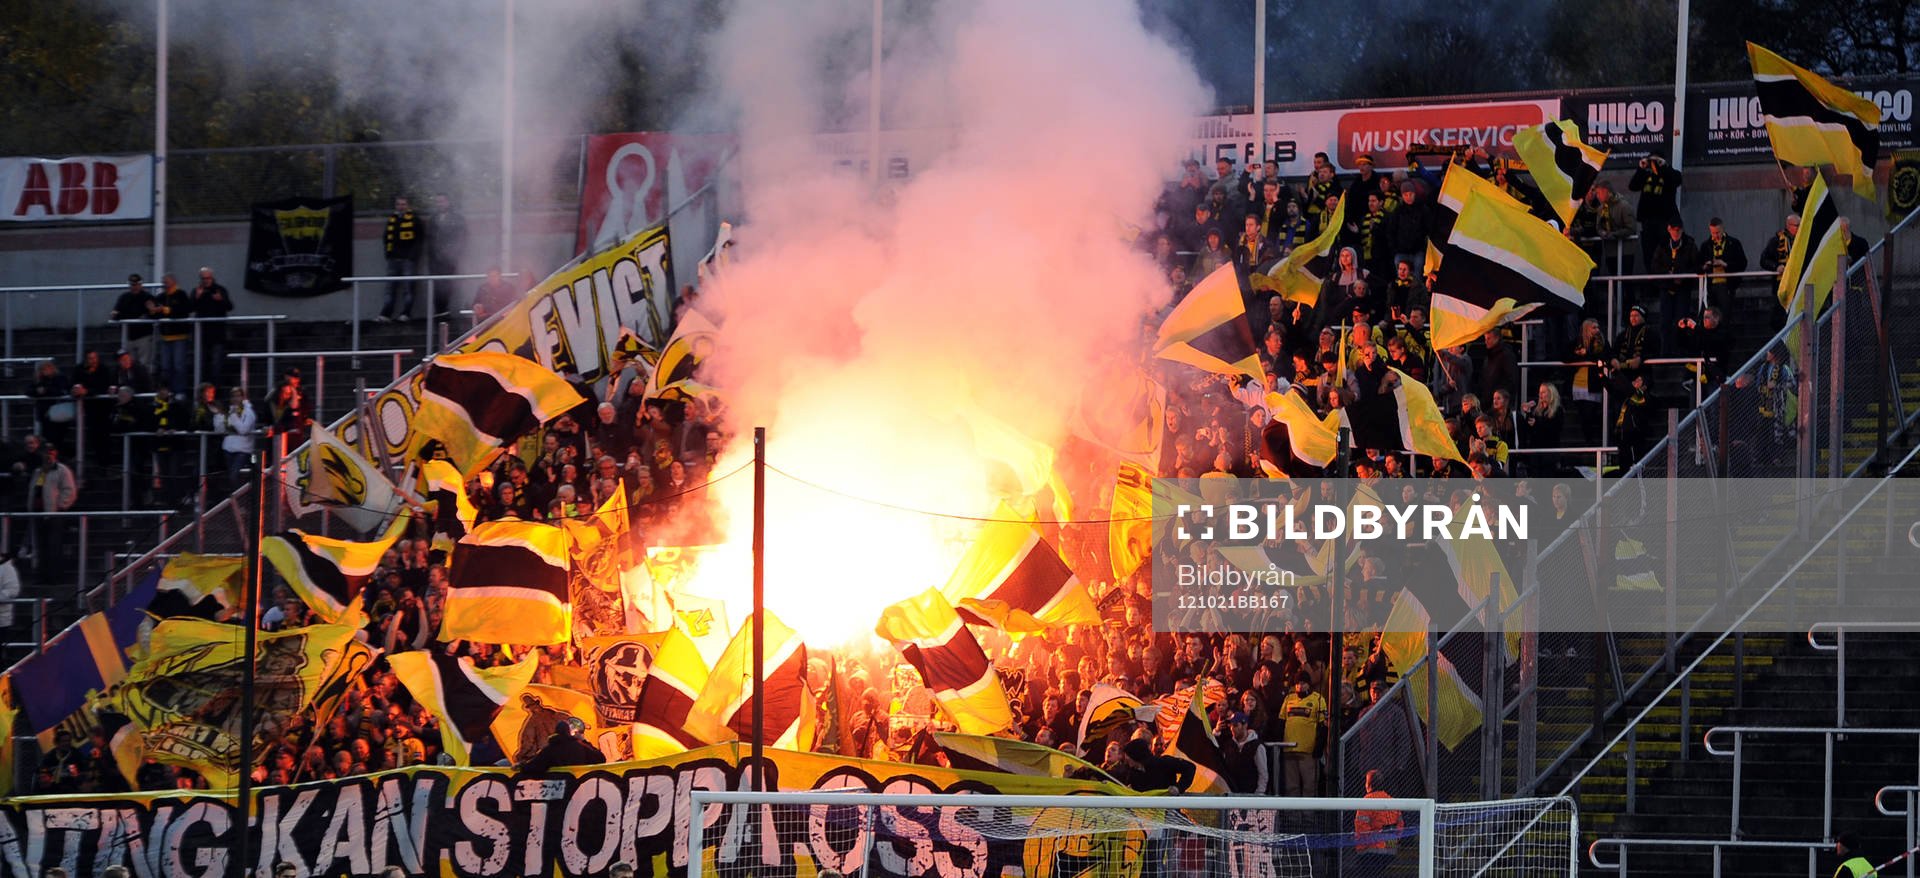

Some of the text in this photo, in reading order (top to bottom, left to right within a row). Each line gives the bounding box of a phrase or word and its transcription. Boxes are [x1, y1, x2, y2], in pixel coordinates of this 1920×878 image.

[1588, 101, 1665, 135] HUGO
[1709, 96, 1765, 130] HUG
[1588, 134, 1664, 145] BAR KÖK BOWLING
[1709, 131, 1723, 141] BAR
[1730, 129, 1745, 140] KÖK
[14, 162, 120, 216] ABB
[528, 240, 671, 376] EVIGT
[0, 802, 231, 878] NTING
[255, 779, 436, 876] KAN
[455, 764, 781, 876] STOPPA
[809, 774, 988, 878] OSS
